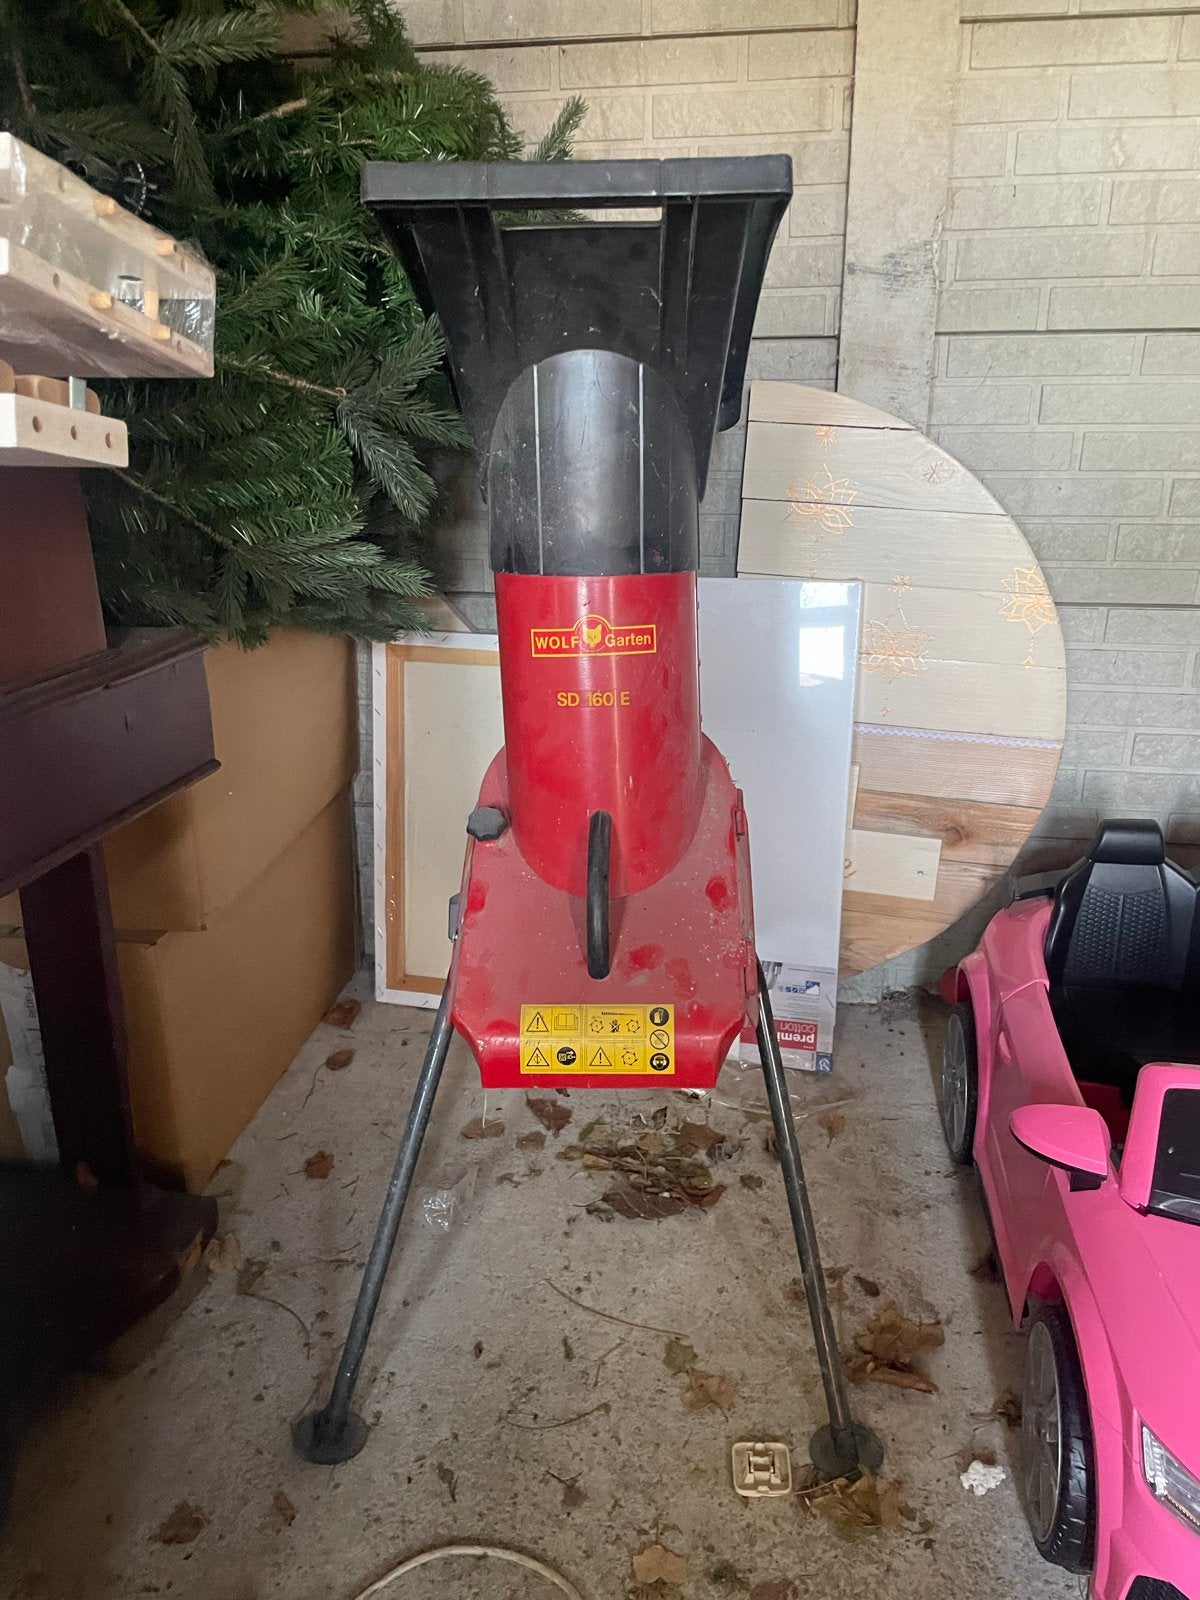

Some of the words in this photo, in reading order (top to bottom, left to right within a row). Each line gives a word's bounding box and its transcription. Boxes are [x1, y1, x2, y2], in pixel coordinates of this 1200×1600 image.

[535, 636, 580, 649] WOLF
[605, 633, 651, 648] Garten
[557, 692, 580, 707] SD
[588, 691, 614, 707] 160
[621, 692, 630, 706] E
[780, 1021, 816, 1034] cotton
[776, 1032, 815, 1044] premi
